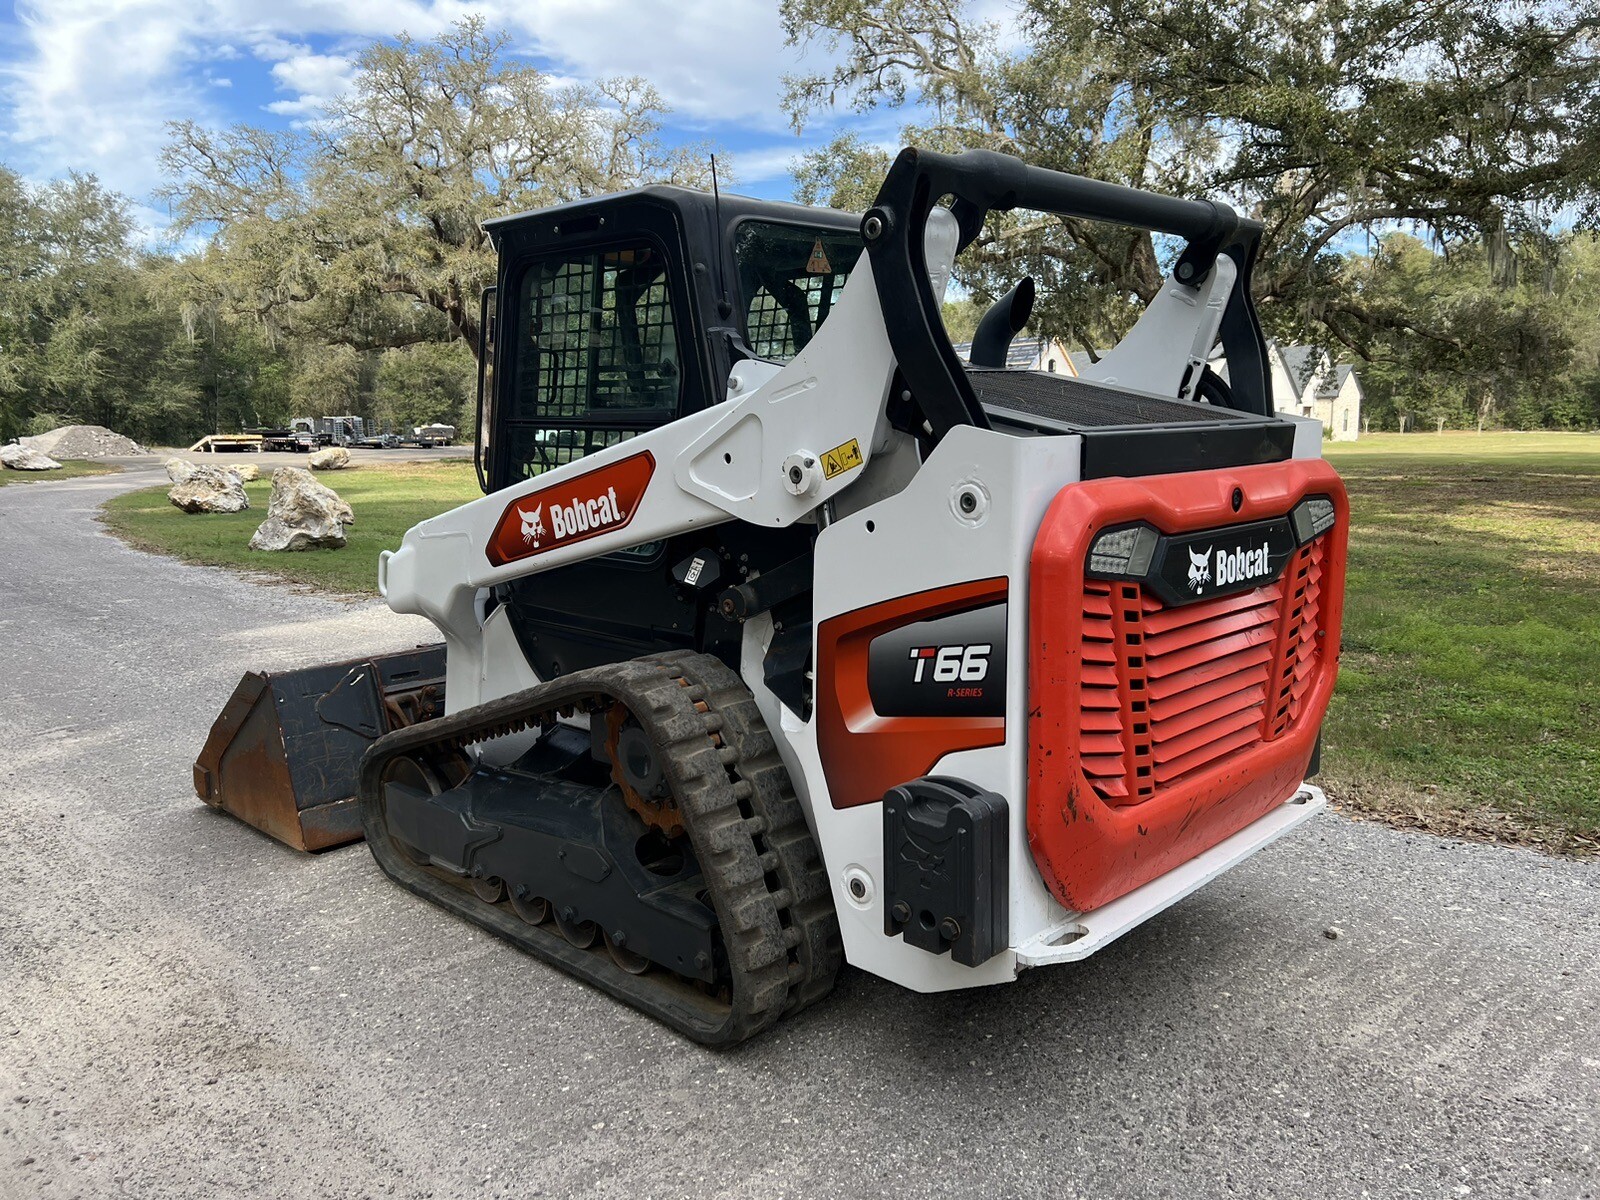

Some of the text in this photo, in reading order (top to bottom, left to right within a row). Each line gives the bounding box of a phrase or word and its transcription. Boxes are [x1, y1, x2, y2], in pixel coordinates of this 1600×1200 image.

[550, 486, 621, 539] Bobcat
[1216, 541, 1269, 586] Bobcat
[910, 645, 991, 682] T66
[947, 688, 983, 697] R-SERIES
